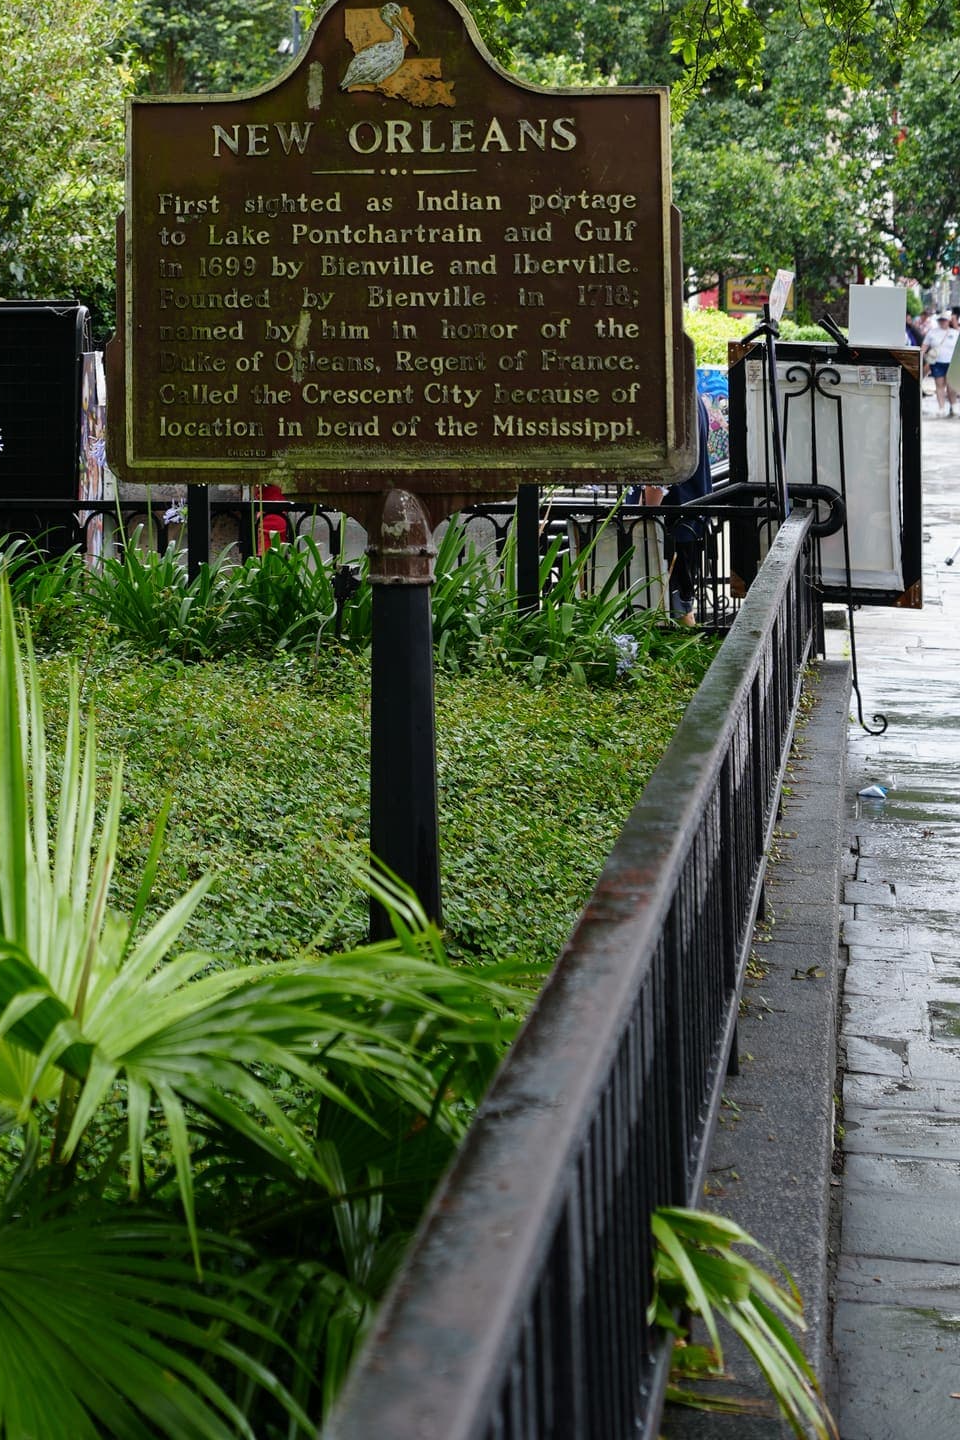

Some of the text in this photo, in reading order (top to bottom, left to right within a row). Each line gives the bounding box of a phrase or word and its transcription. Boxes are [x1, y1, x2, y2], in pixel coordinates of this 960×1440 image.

[211, 116, 577, 157] NEW ORLEANS
[158, 190, 637, 218] First sighted as Indian portage
[159, 219, 637, 246] to Lake Pontchartrain and Gulf
[159, 253, 639, 279] in 1699 by Bienville and Iberville.
[159, 287, 271, 309] Founded
[302, 287, 336, 310] by
[367, 285, 486, 308] Bienville
[518, 287, 545, 307] in
[159, 317, 640, 343] named by him in honor of the
[159, 350, 227, 373] Duke
[235, 351, 264, 372] of
[395, 350, 487, 377] Regent
[498, 350, 529, 372] of
[541, 349, 640, 372] France.
[159, 382, 641, 409] Called the Crescent City because of
[159, 415, 641, 442] location in bend of the Mississippi.
